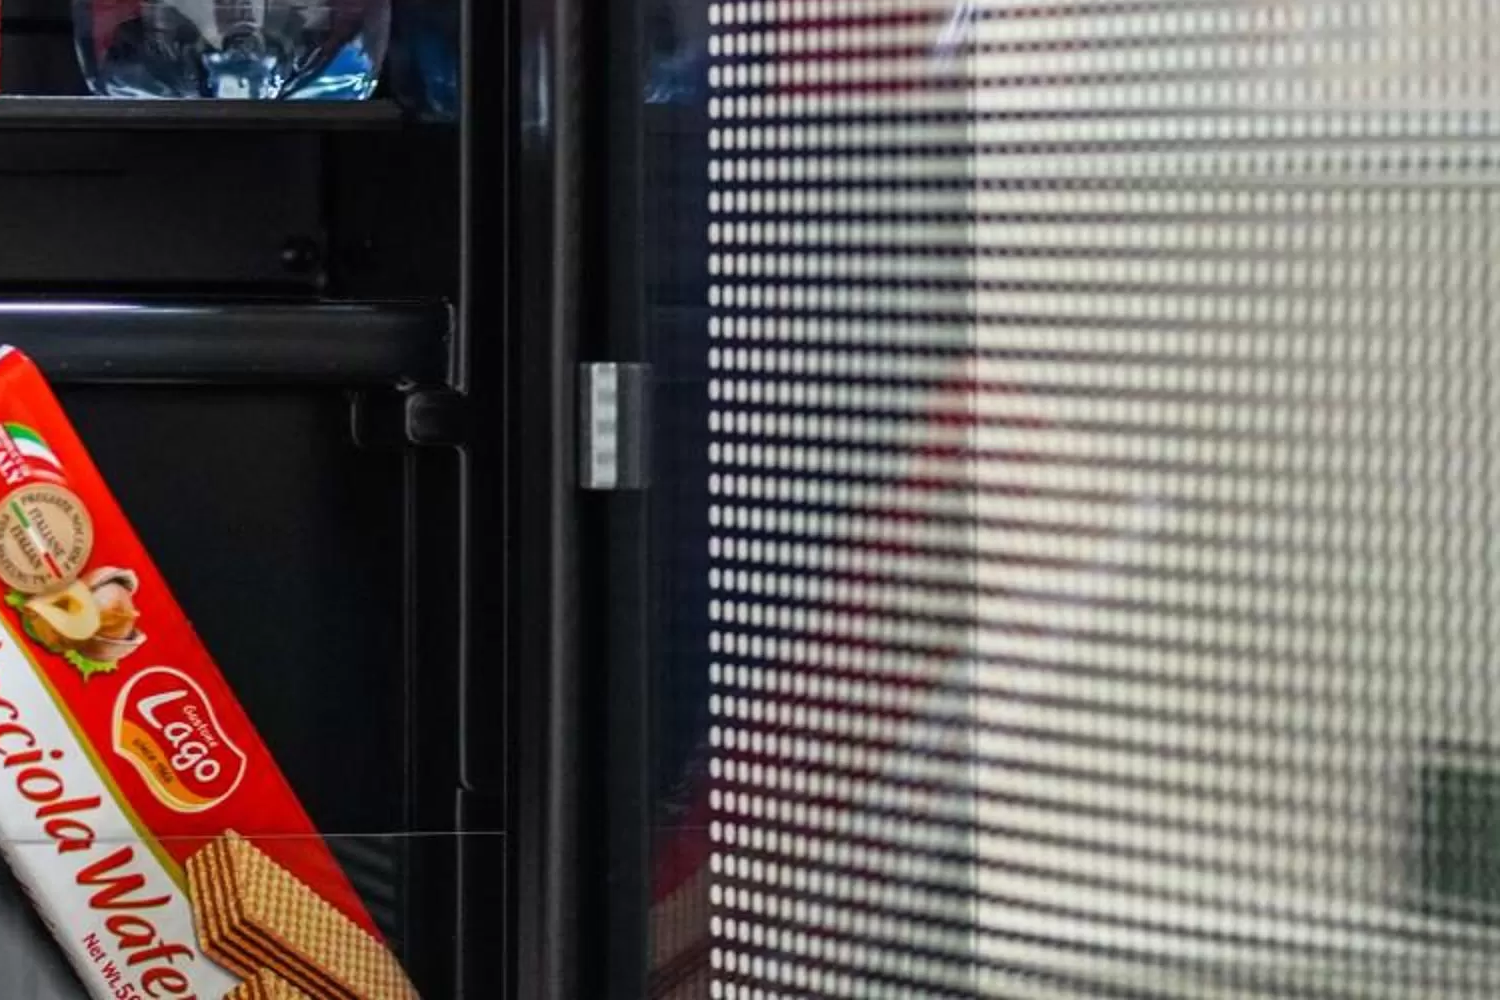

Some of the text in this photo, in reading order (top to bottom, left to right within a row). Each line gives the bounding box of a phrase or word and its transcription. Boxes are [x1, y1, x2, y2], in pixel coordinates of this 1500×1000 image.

[136, 689, 220, 782] Lago
[76, 846, 197, 1000] Wafe
[83, 932, 106, 963] Net
